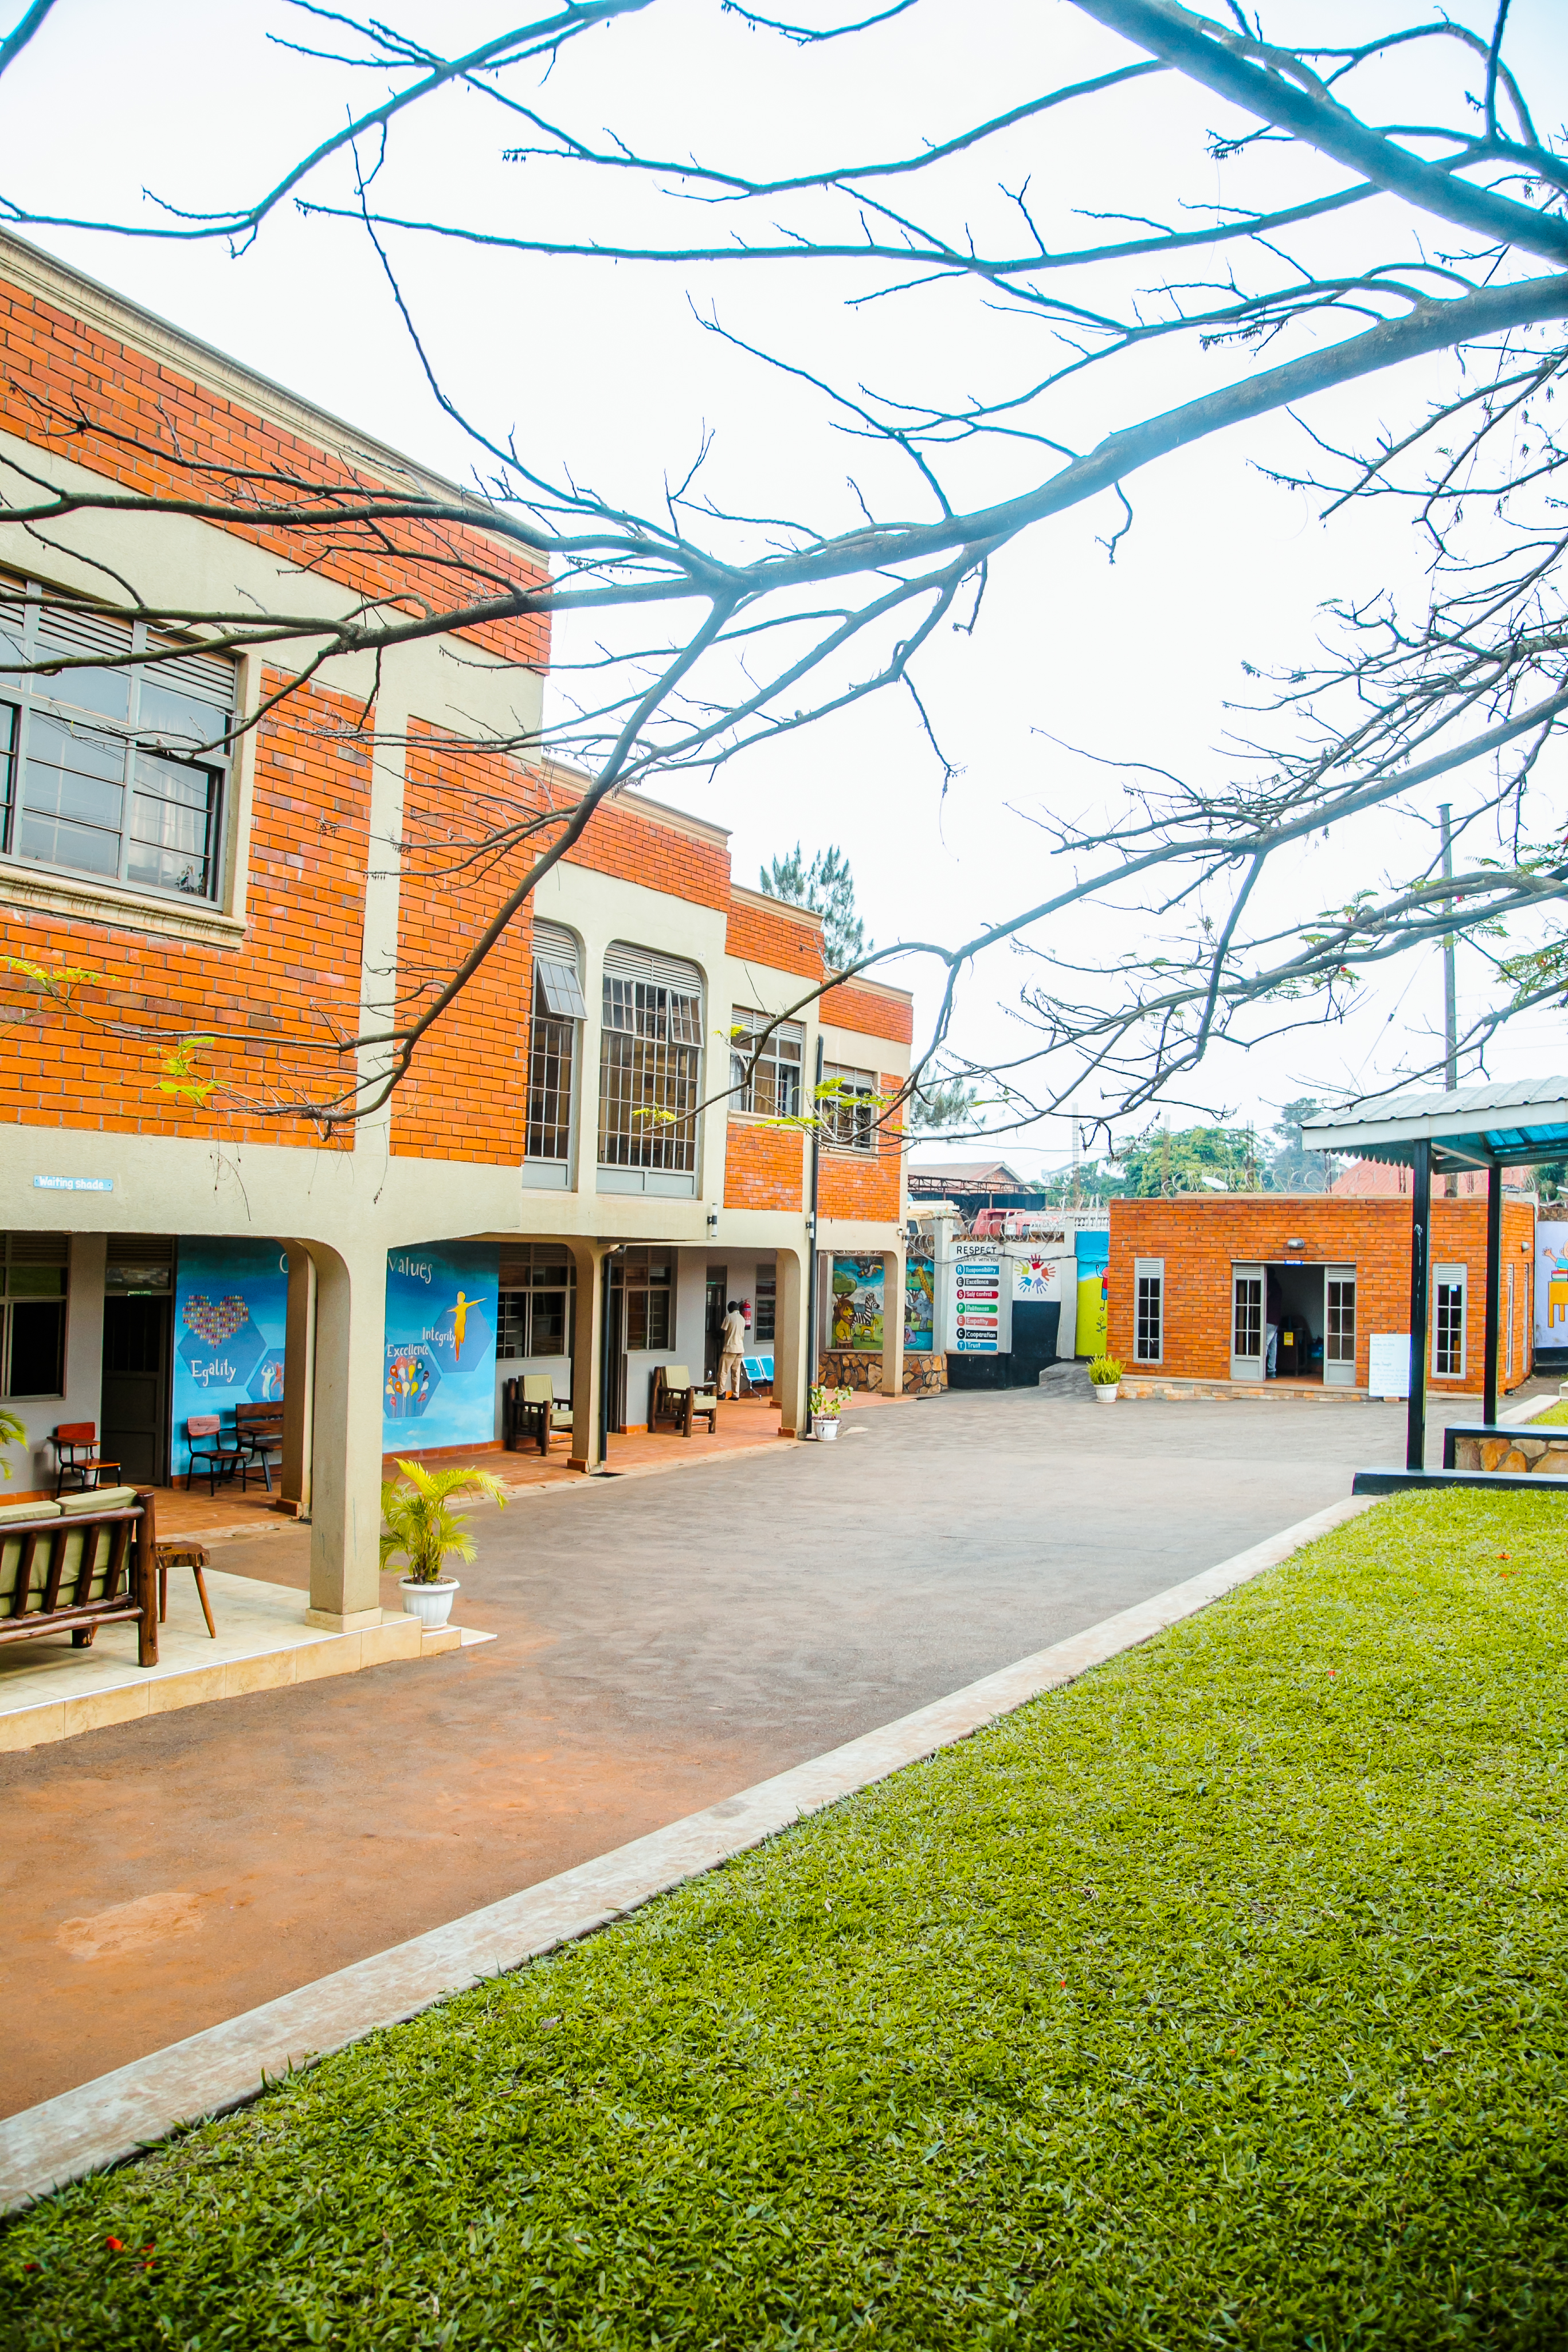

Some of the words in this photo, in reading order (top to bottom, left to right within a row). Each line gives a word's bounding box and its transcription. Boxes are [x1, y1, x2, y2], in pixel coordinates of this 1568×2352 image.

[39, 1175, 73, 1189] Waiting
[75, 1179, 104, 1189] shade
[957, 1246, 997, 1255] RESPECT
[967, 1317, 989, 1325] Empathy
[422, 1326, 456, 1349] Integrity
[387, 1343, 429, 1357] Excellence
[191, 1358, 237, 1387] Egality
